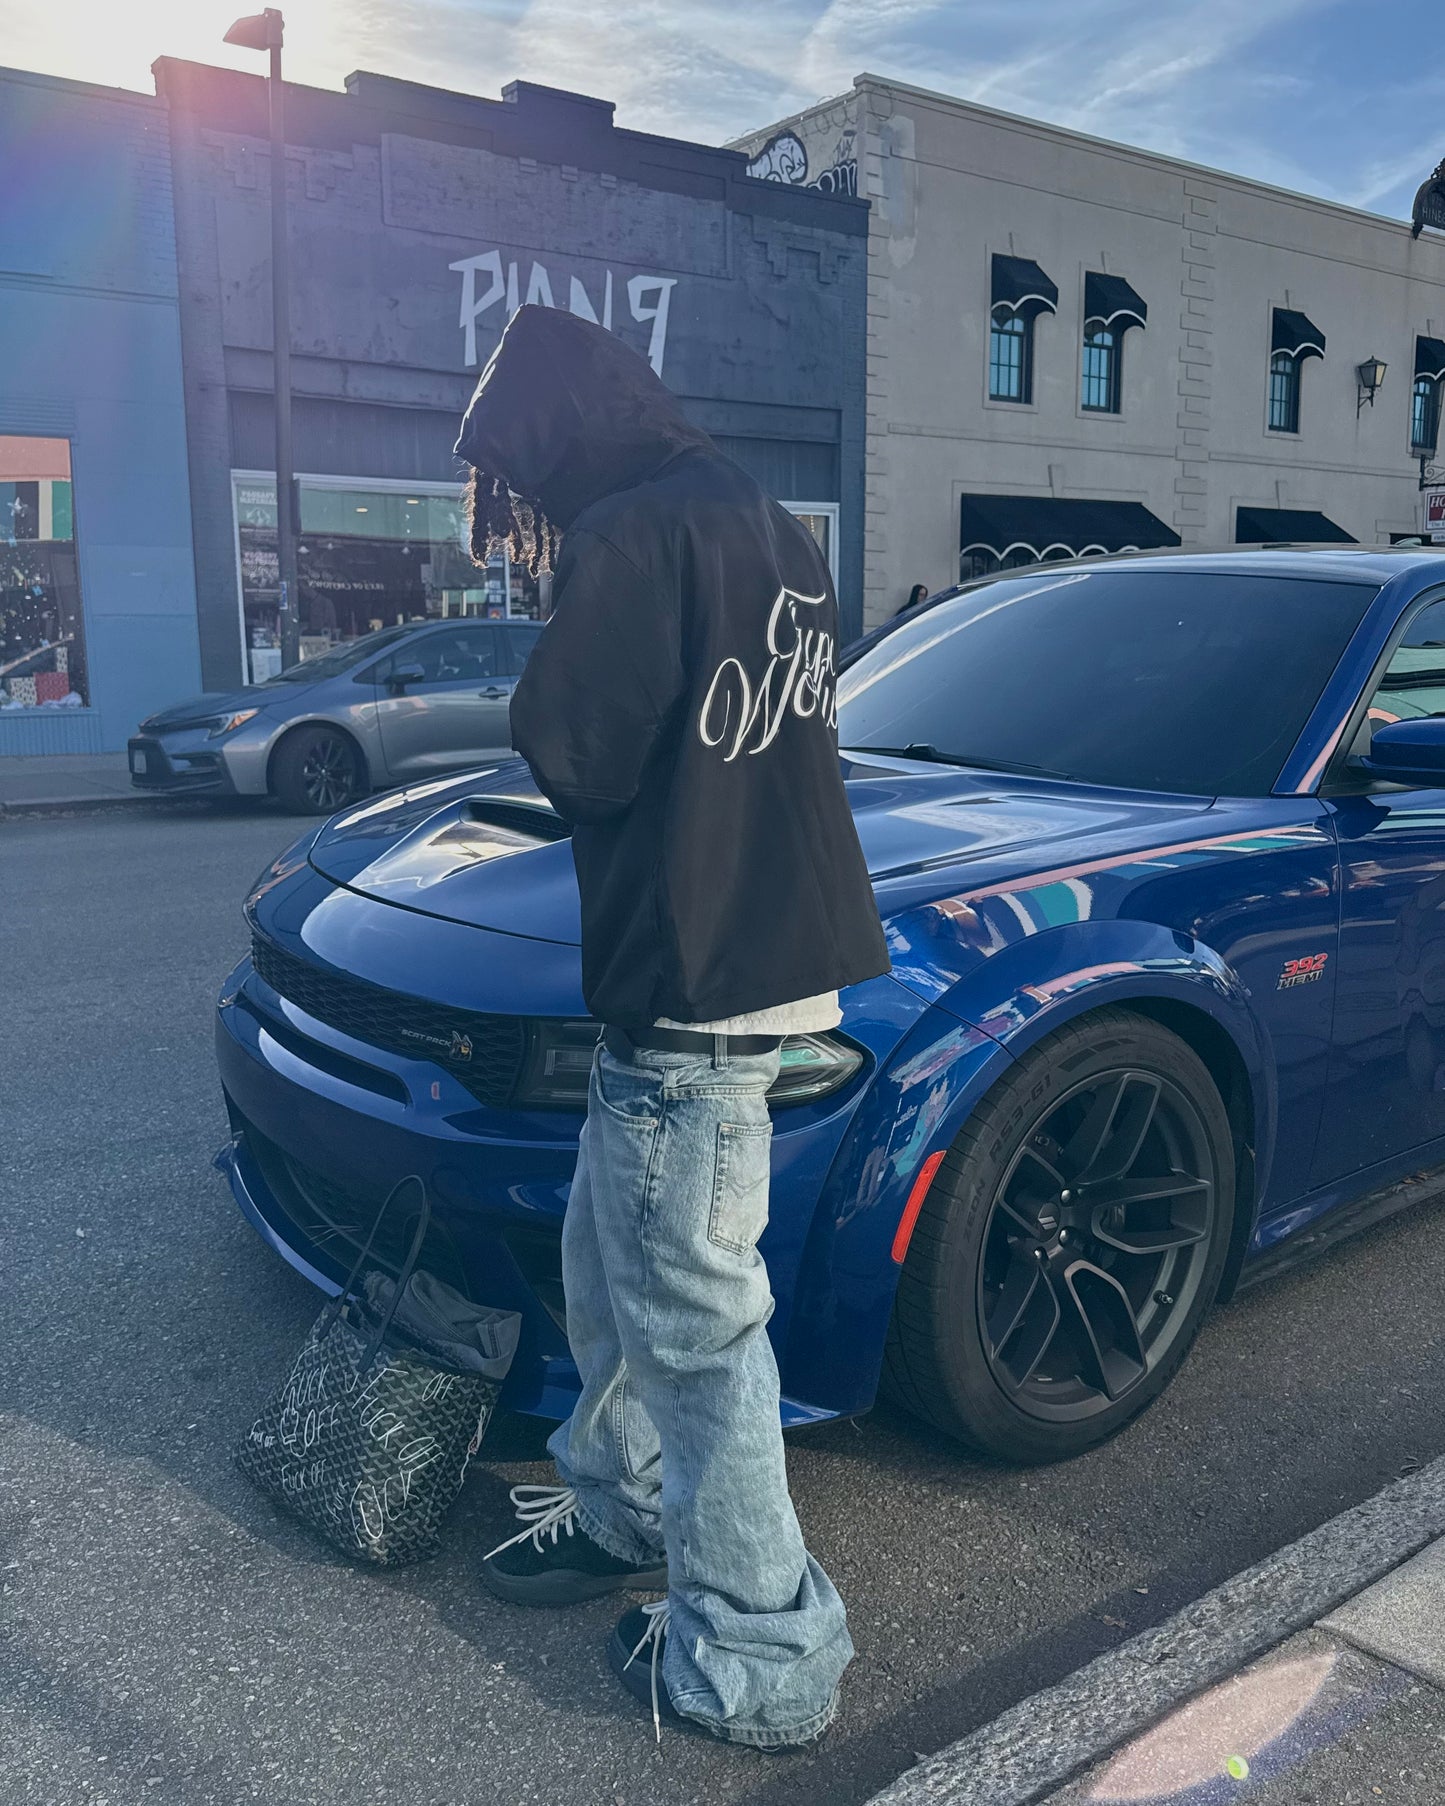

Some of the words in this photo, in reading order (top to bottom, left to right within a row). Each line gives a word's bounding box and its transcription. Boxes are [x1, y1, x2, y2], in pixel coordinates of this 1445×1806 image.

[627, 275, 678, 378] 9
[1276, 970, 1323, 990] HEMI
[1281, 952, 1328, 978] 392
[401, 1028, 426, 1040] SCAT
[426, 1036, 452, 1047] PACK
[989, 1073, 1052, 1163] RS3-G1
[281, 1344, 329, 1406] FUCK
[304, 1401, 341, 1447] OFF
[351, 1367, 410, 1449] FUCK
